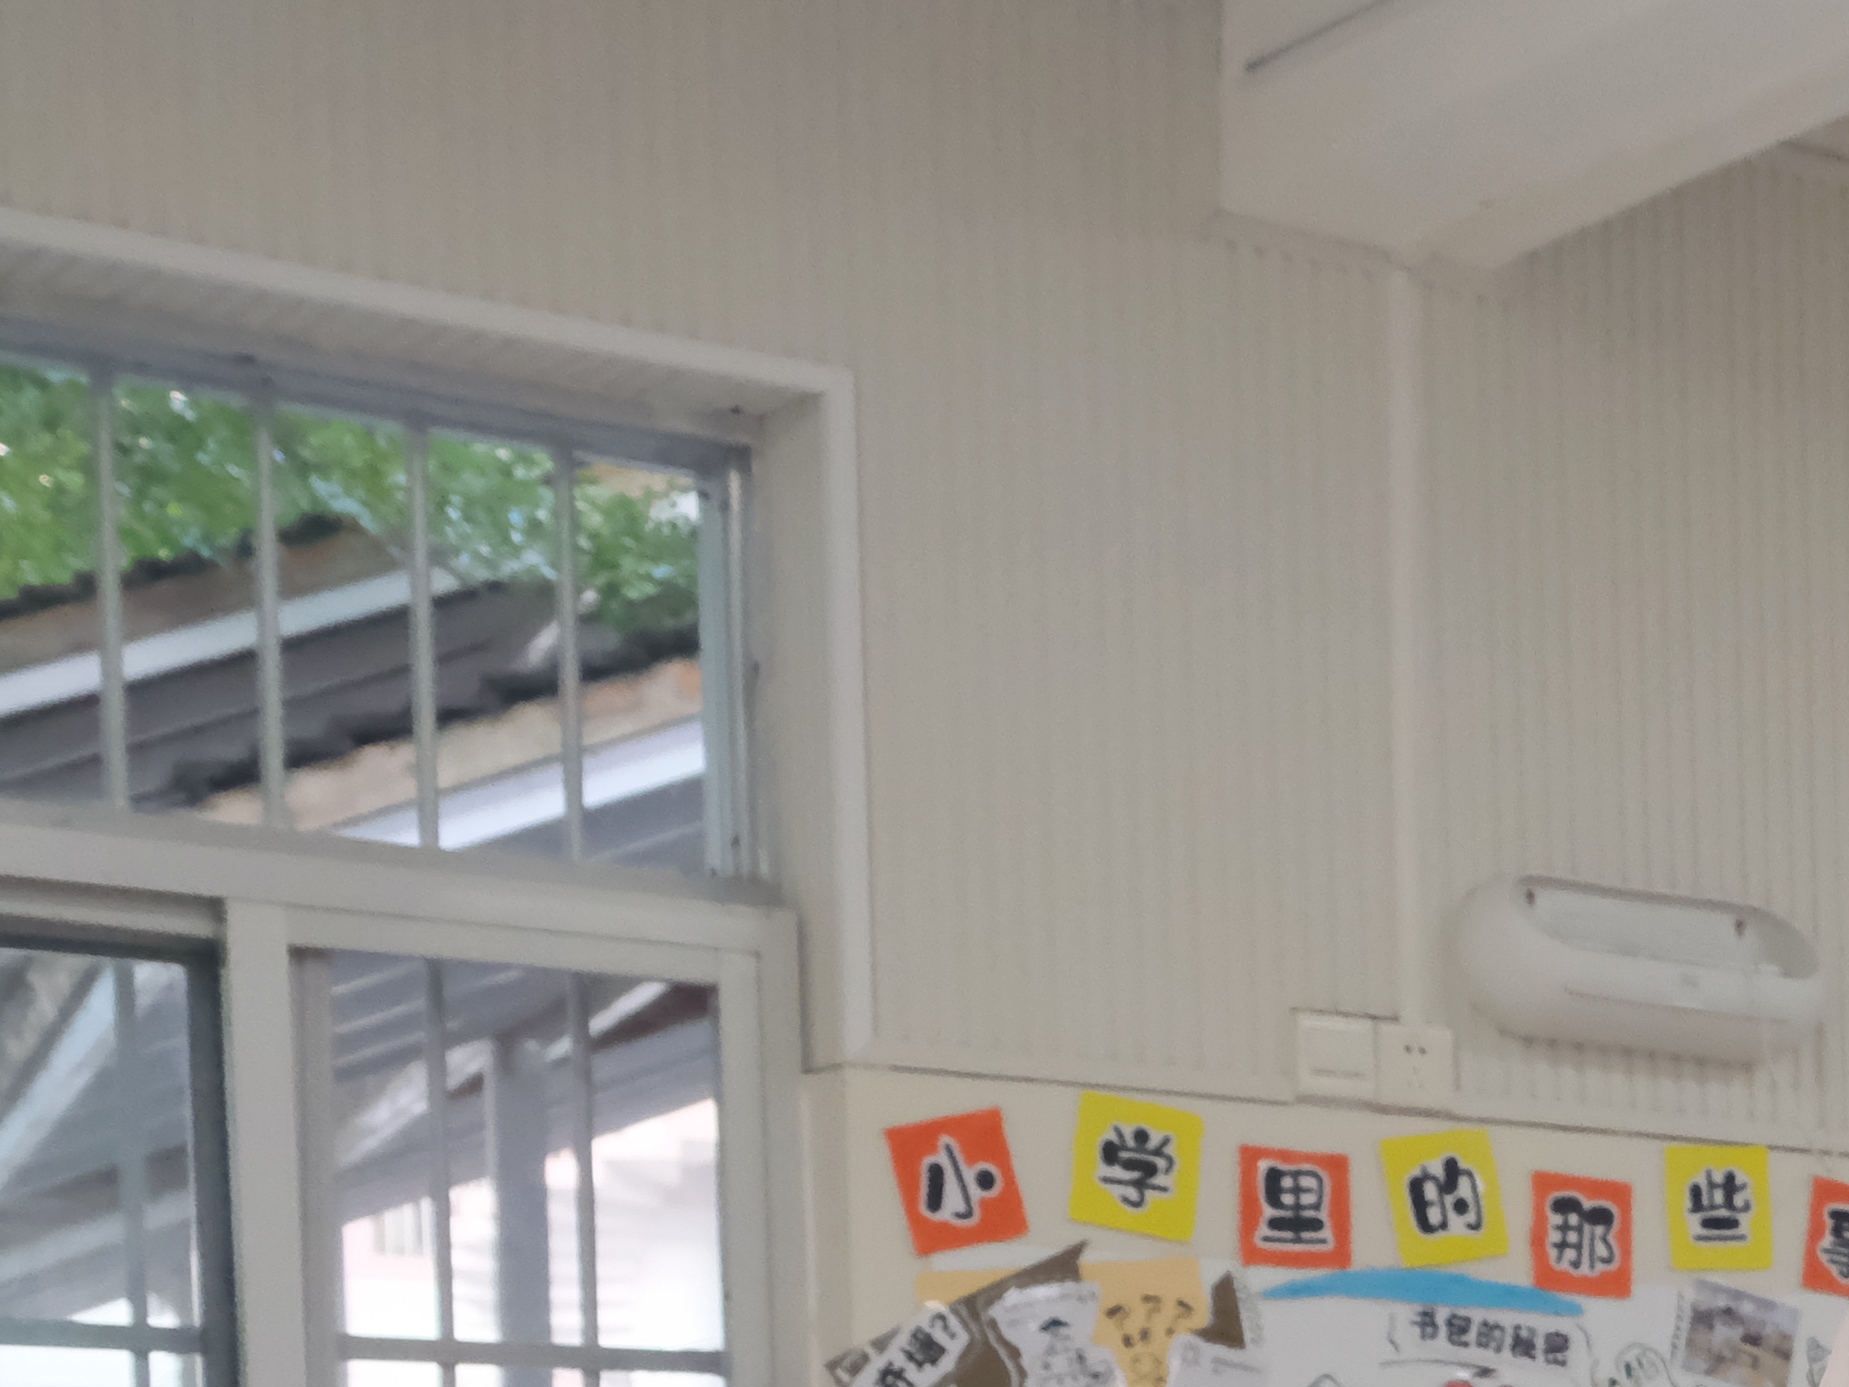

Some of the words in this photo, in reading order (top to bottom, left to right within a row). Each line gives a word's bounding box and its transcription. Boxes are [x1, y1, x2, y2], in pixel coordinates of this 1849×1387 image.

[1411, 1307, 1570, 1367] 书包的秘密
